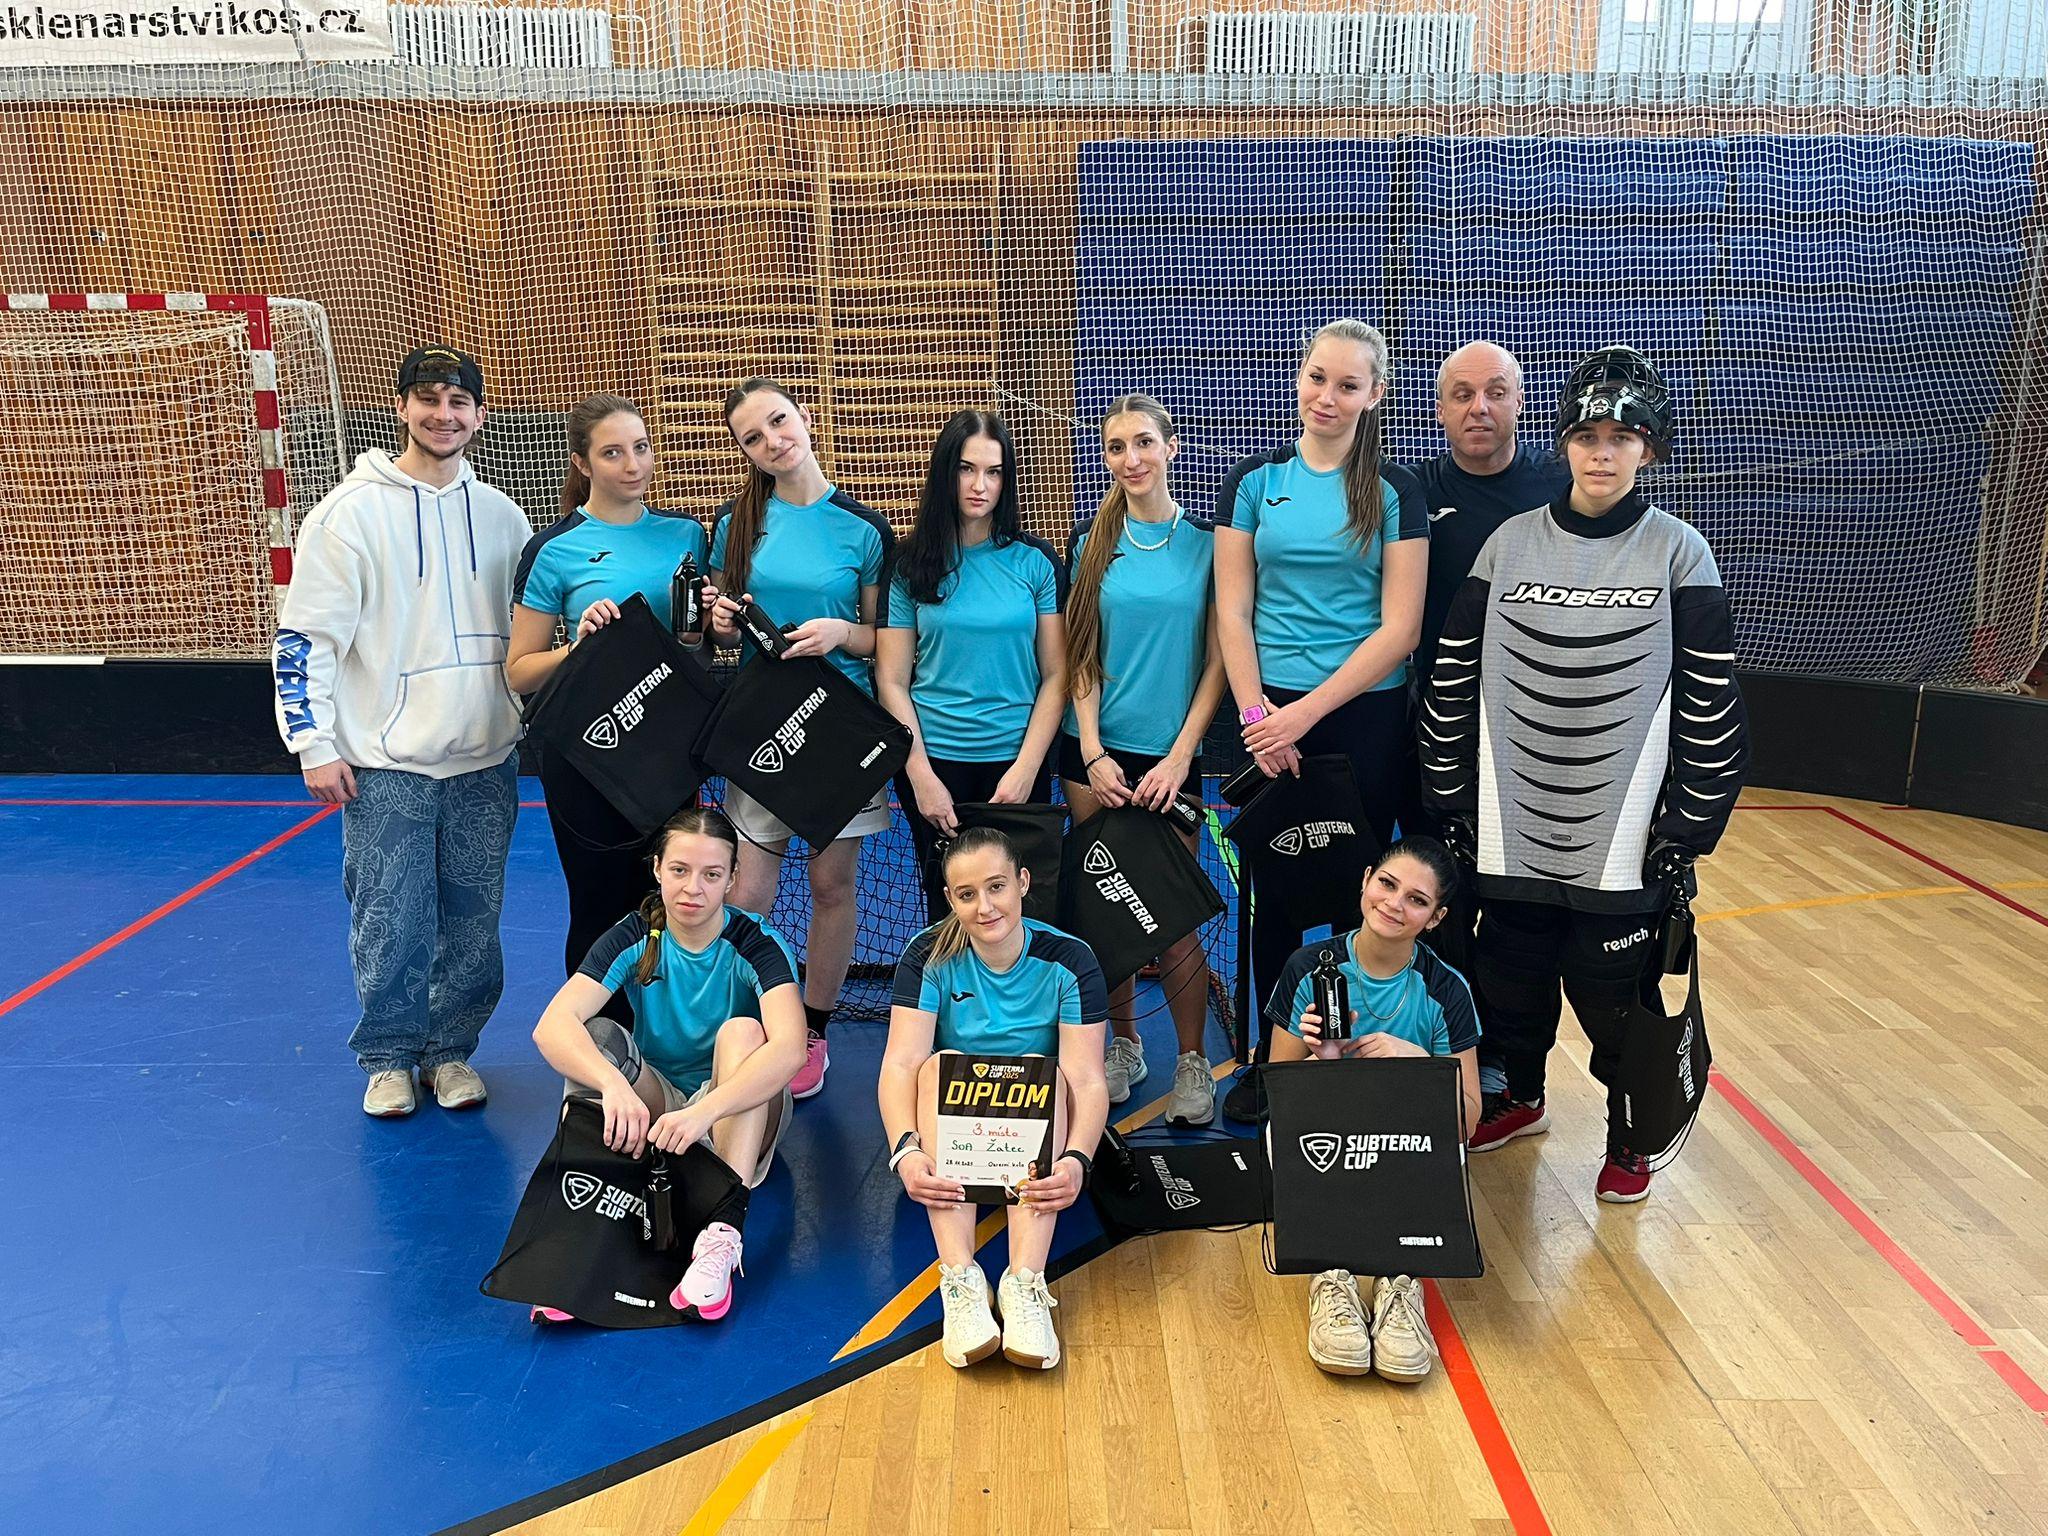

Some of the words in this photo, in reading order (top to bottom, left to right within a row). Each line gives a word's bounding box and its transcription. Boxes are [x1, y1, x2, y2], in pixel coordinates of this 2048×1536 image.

[1500, 582, 1663, 609] JADBERG
[613, 662, 673, 720] SUBTERRA
[621, 704, 645, 732] CUP
[775, 686, 829, 744] SUBTERRA
[782, 728, 807, 757] CUP
[1304, 821, 1356, 836] SUBTERRA
[1307, 834, 1331, 849] CUP
[1095, 877, 1122, 904] CUP
[1107, 871, 1159, 935] SUBTERRA
[1603, 927, 1649, 953] reusch
[990, 1065, 1024, 1074] SUBTERRA
[945, 1080, 1050, 1109] DIPLOM
[1344, 1133, 1432, 1154] SUBTERRA
[1149, 1155, 1179, 1190] SUBTERRA
[1343, 1152, 1379, 1170] CUP
[595, 1198, 626, 1221] CUP
